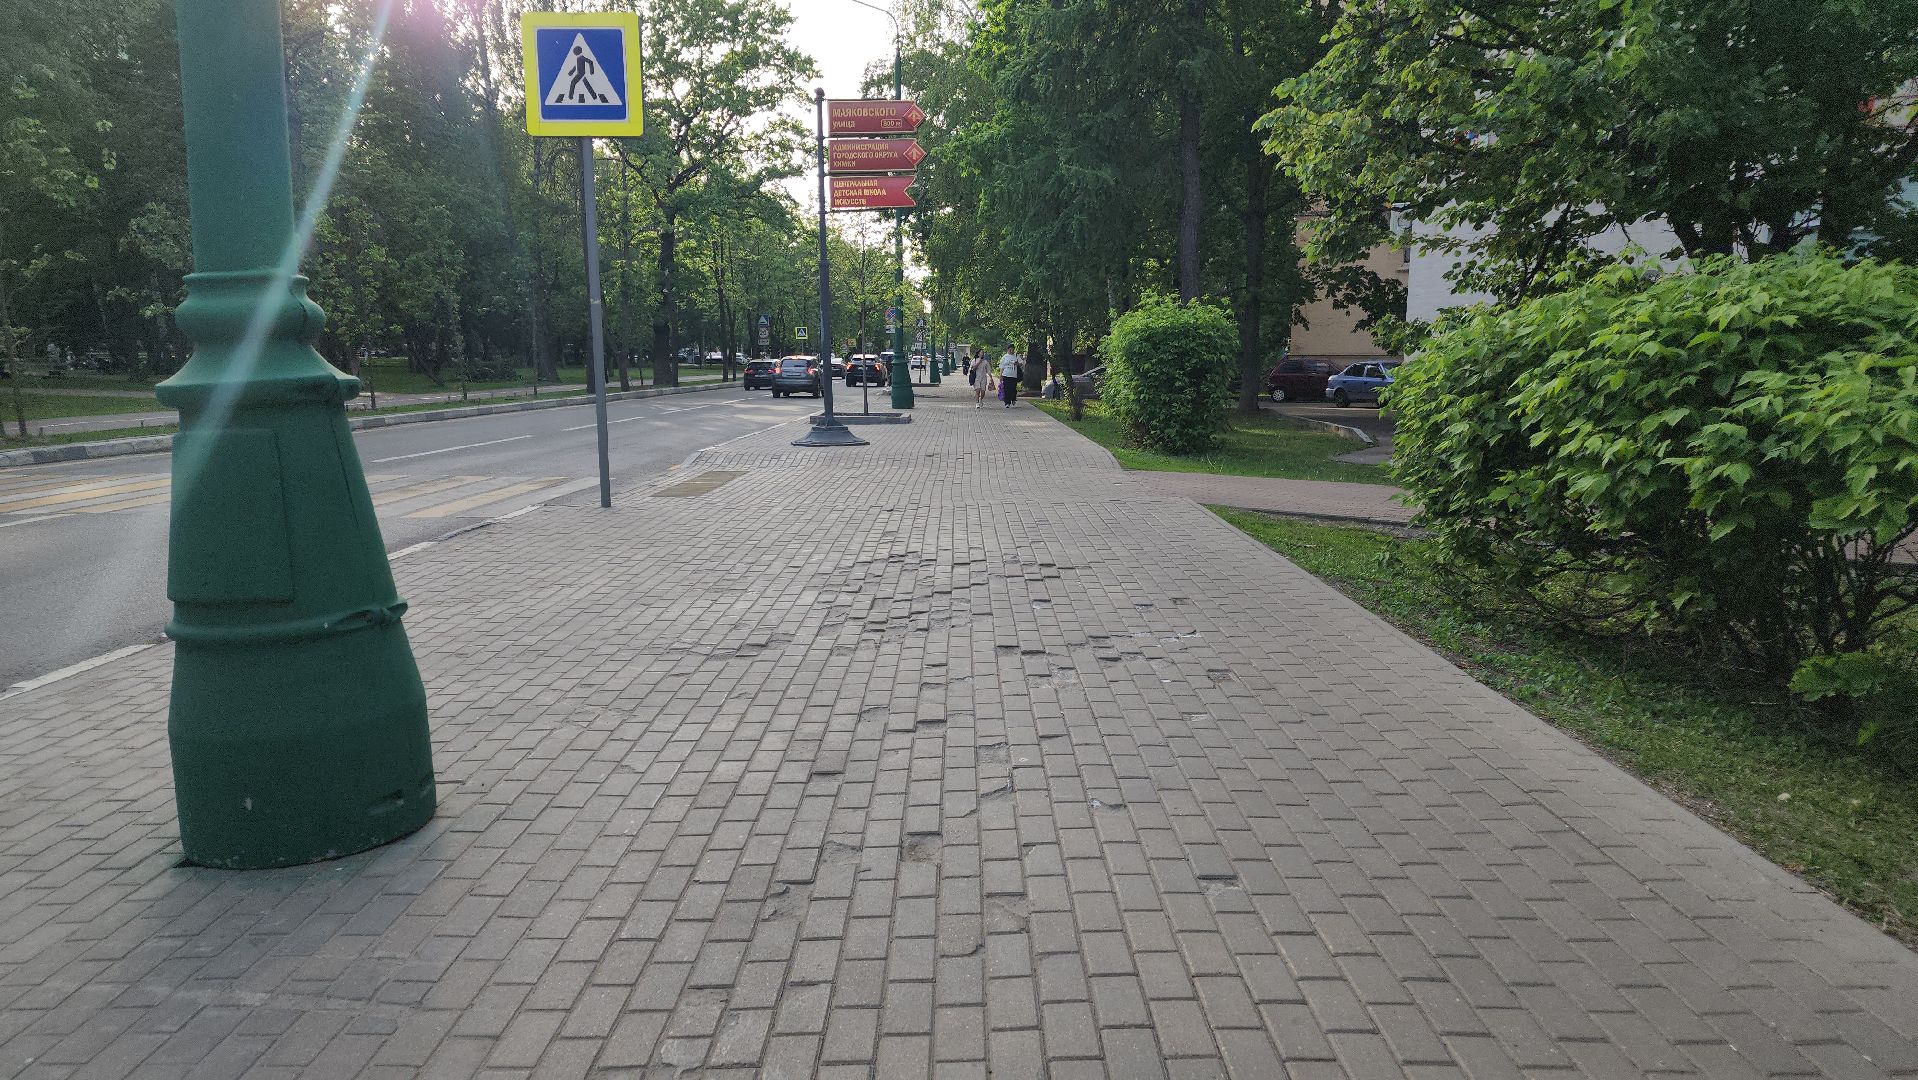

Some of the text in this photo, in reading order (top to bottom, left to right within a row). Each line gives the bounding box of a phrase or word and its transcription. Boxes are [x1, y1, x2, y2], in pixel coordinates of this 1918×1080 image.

[832, 108, 896, 117] МАЯКОВСКОГО
[832, 121, 855, 129] улица
[833, 143, 889, 151] АДМИНИСТРАЦИЯ
[833, 180, 878, 188] ЦЕНТРАЛЬНАЯ
[834, 188, 886, 197] ДЕТСКАЯ ШКОЛА
[834, 198, 867, 206] ИСКУССТВ
